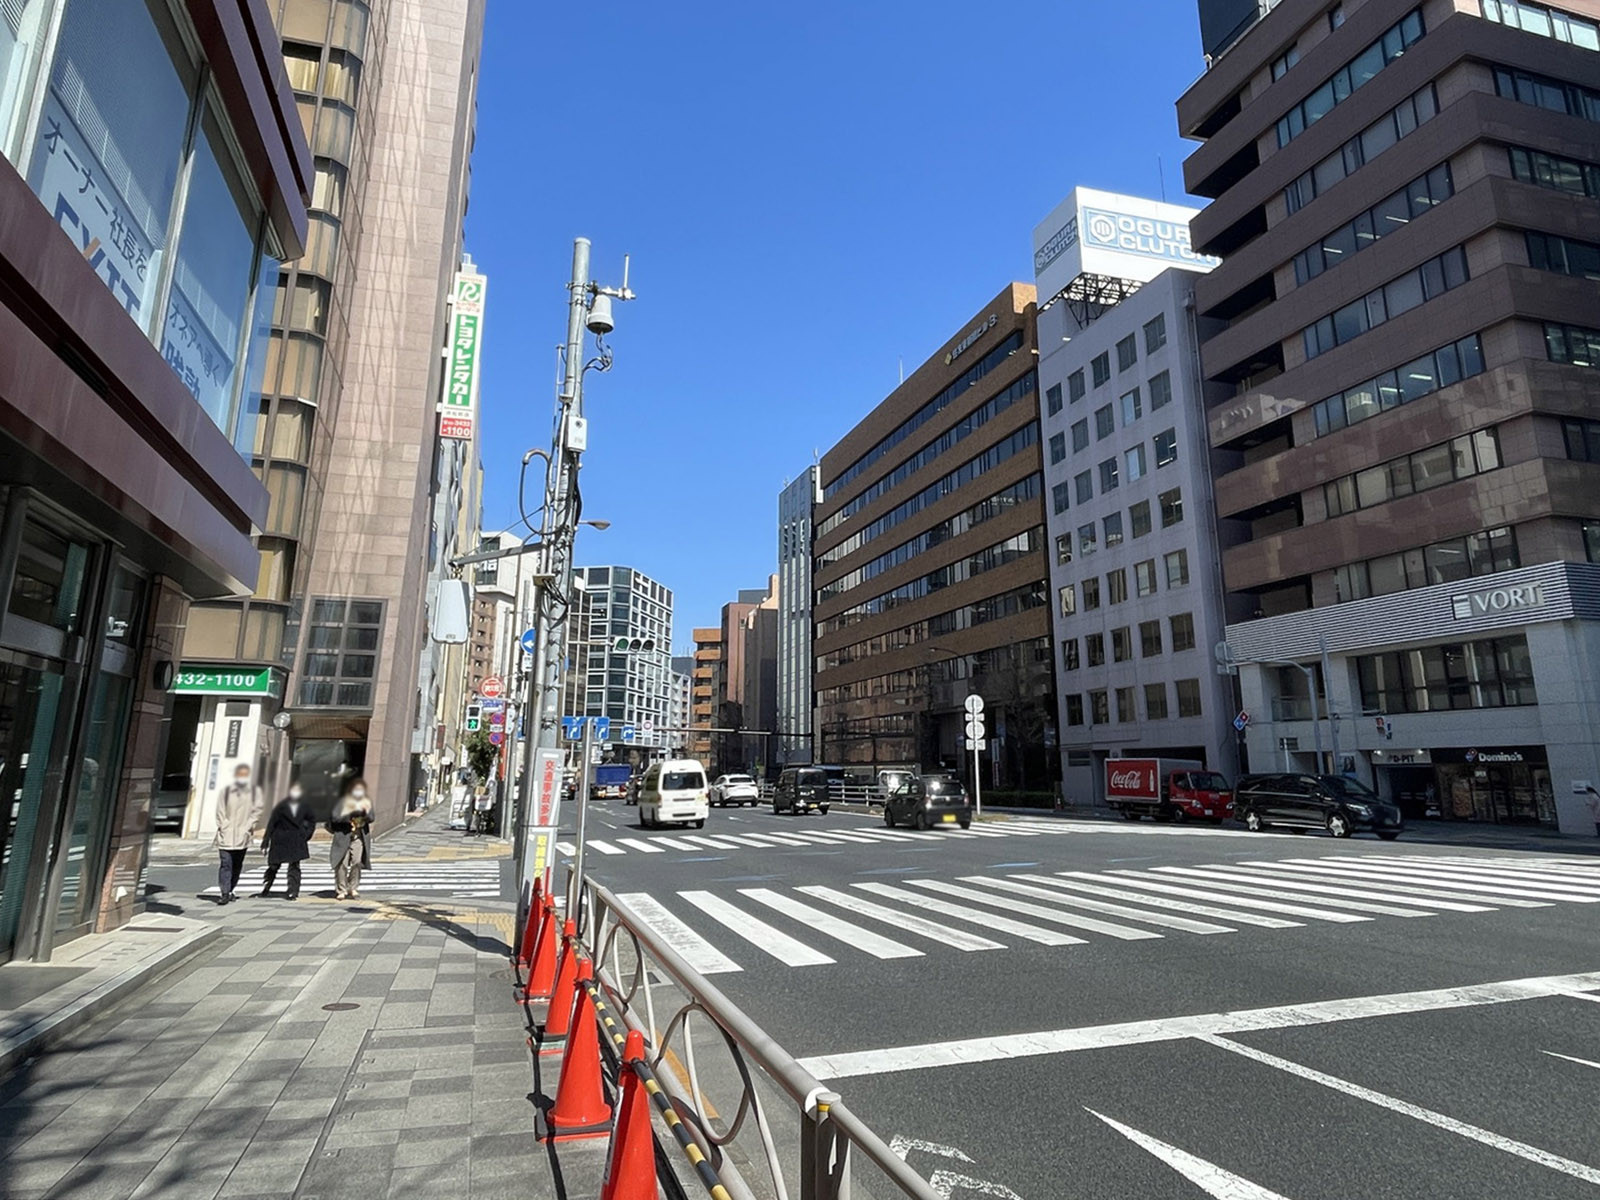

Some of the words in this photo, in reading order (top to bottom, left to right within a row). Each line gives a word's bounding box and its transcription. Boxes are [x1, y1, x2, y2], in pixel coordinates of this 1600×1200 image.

[44, 116, 147, 282] オーナー社長を
[1044, 220, 1077, 253] OGURA
[1118, 217, 1191, 243] OGUR
[451, 315, 474, 405] トヨタレンタカー
[1474, 586, 1539, 612] VORT
[1478, 752, 1524, 762] Domino's
